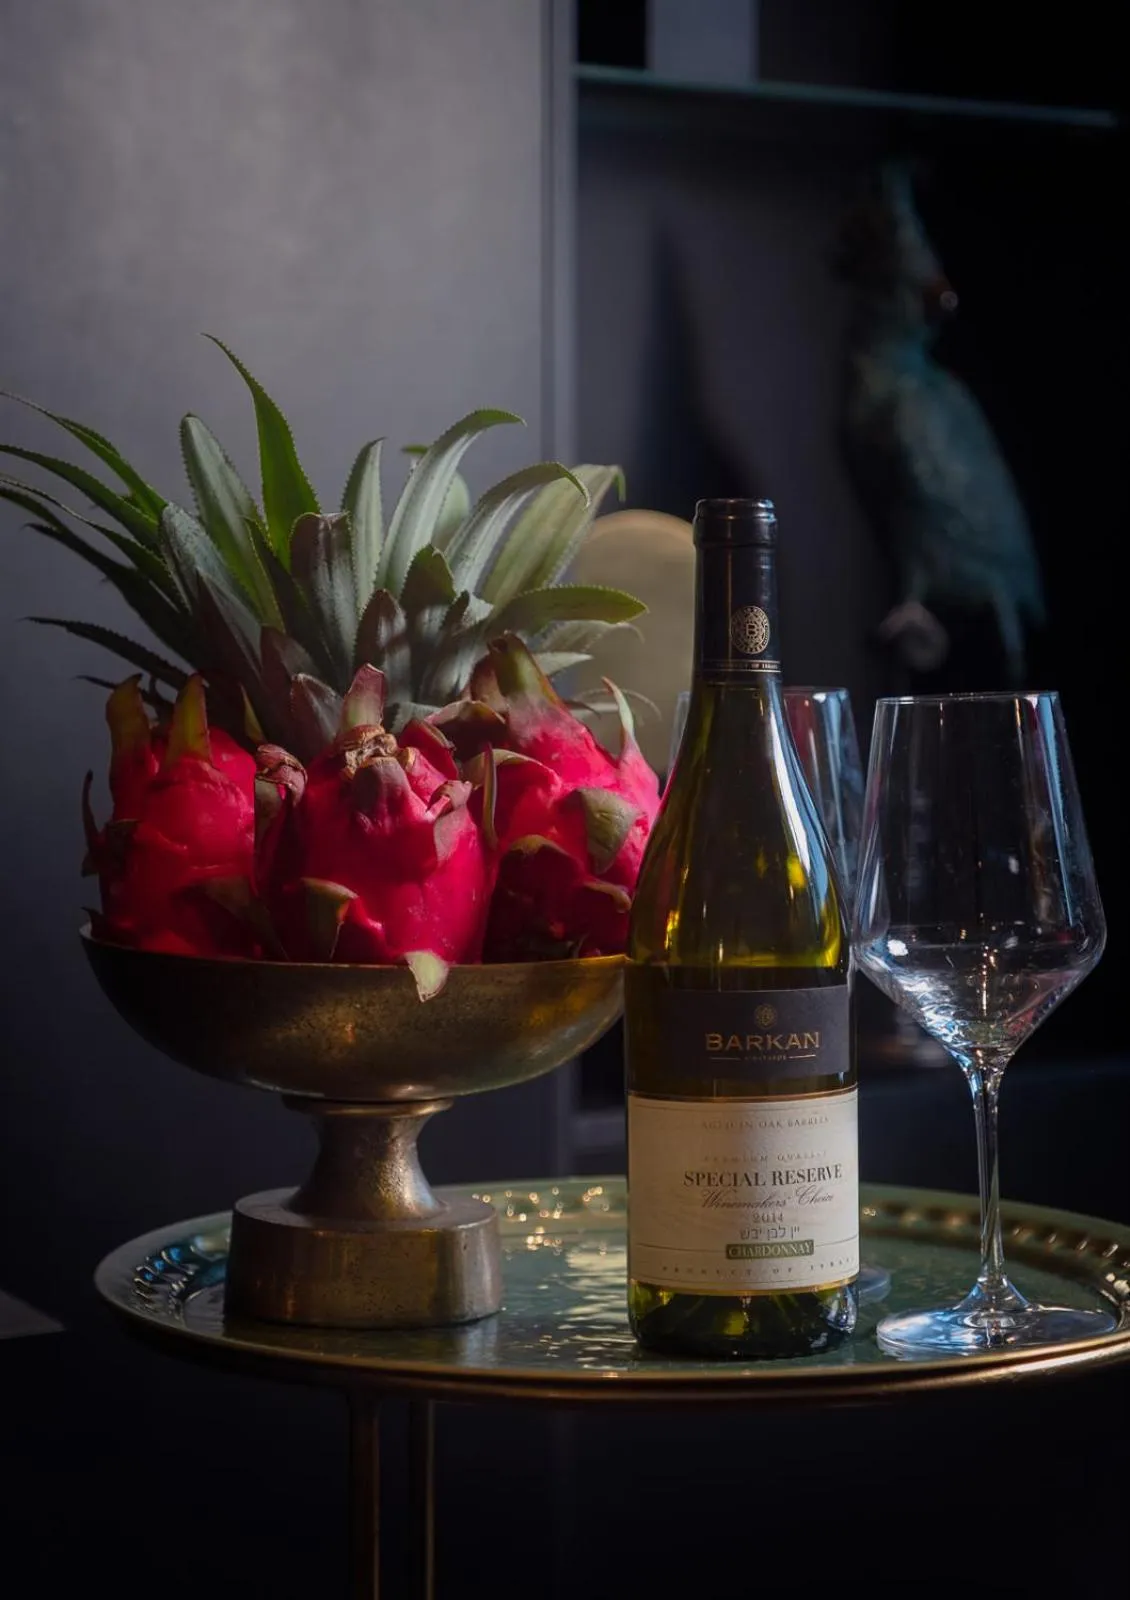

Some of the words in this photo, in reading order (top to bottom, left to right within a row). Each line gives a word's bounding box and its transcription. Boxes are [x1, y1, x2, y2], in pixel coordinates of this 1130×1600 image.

[705, 1031, 820, 1051] BARKAN
[759, 1118, 783, 1129] OAK
[683, 1169, 767, 1187] SPECIAL
[771, 1163, 842, 1186] RESERVE
[752, 1212, 784, 1224] 2014
[728, 1241, 813, 1257] CHARDONNAY
